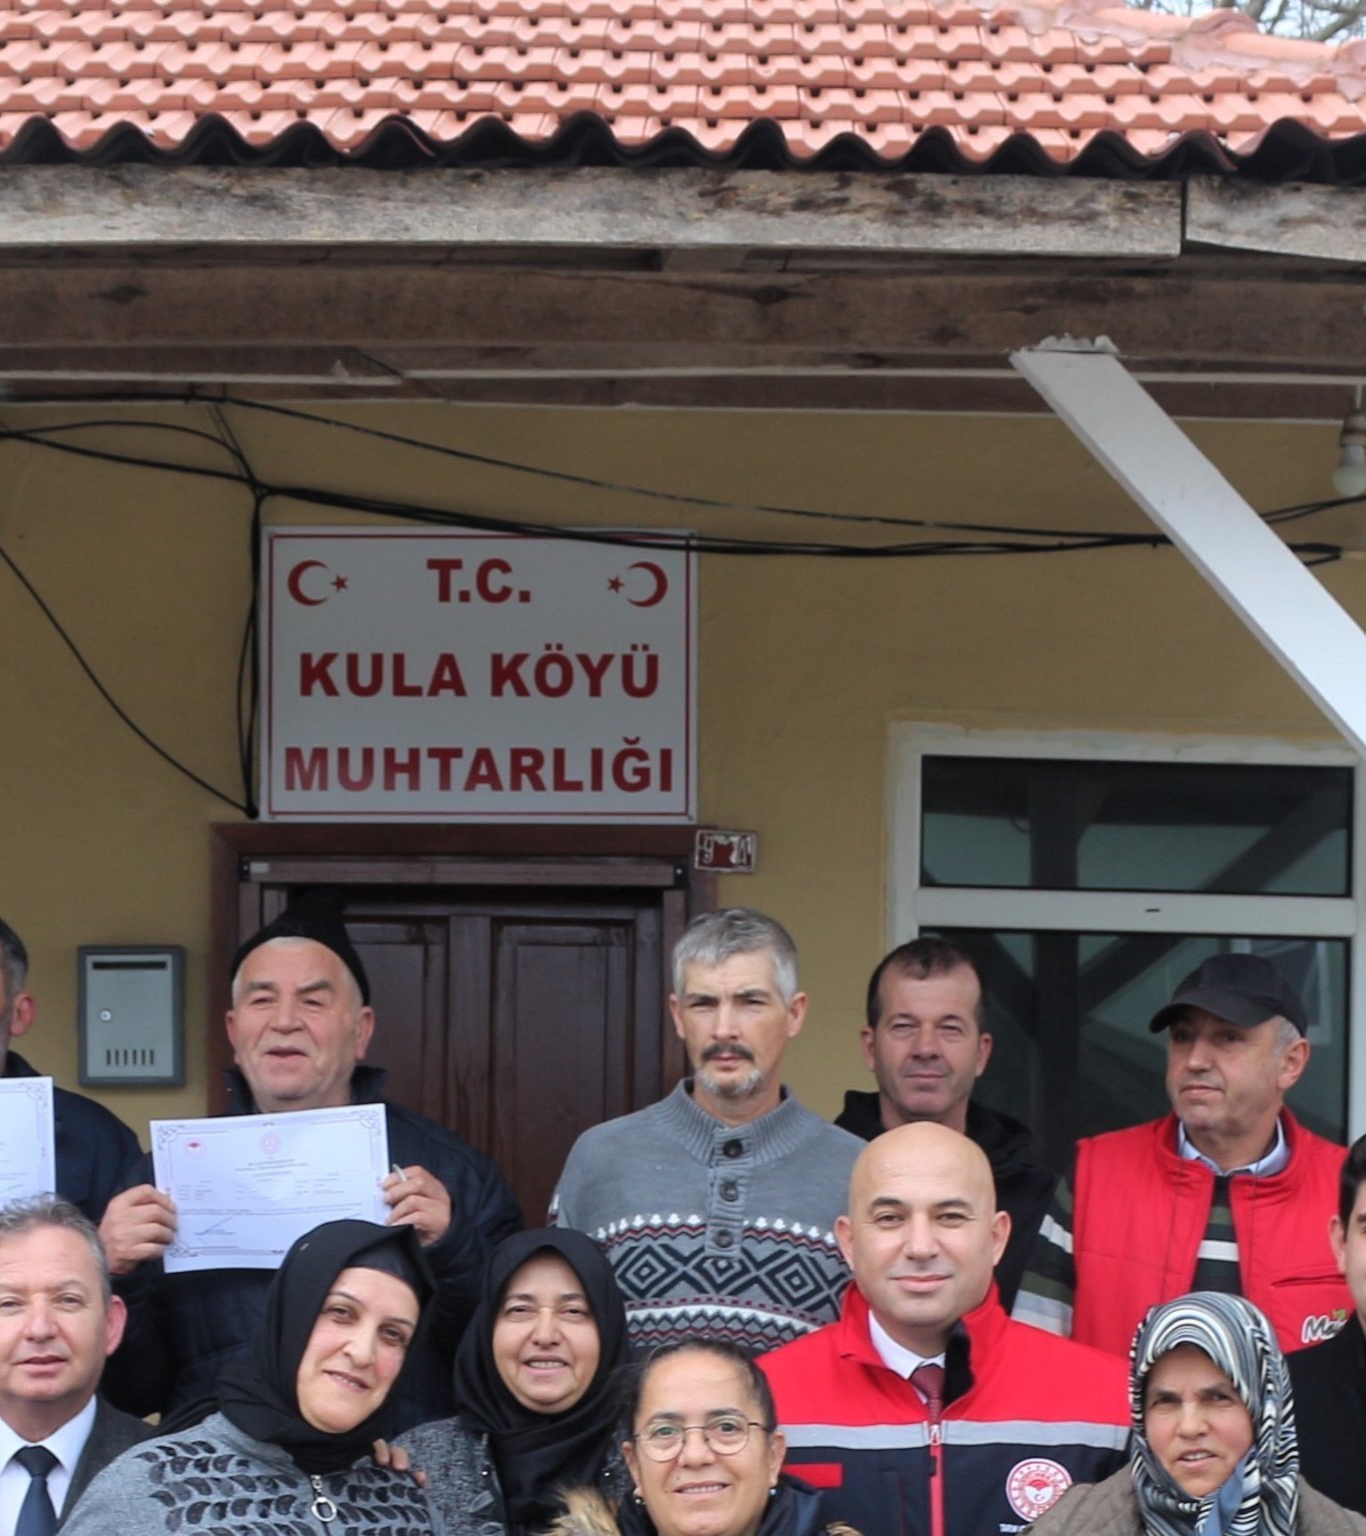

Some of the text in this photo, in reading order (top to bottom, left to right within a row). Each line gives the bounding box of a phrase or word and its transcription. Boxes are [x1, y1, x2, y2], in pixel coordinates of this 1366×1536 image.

[426, 558, 532, 604] T.C.
[299, 643, 660, 698] KULA KÖYÜ
[284, 736, 674, 793] MUHTARLIĞI
